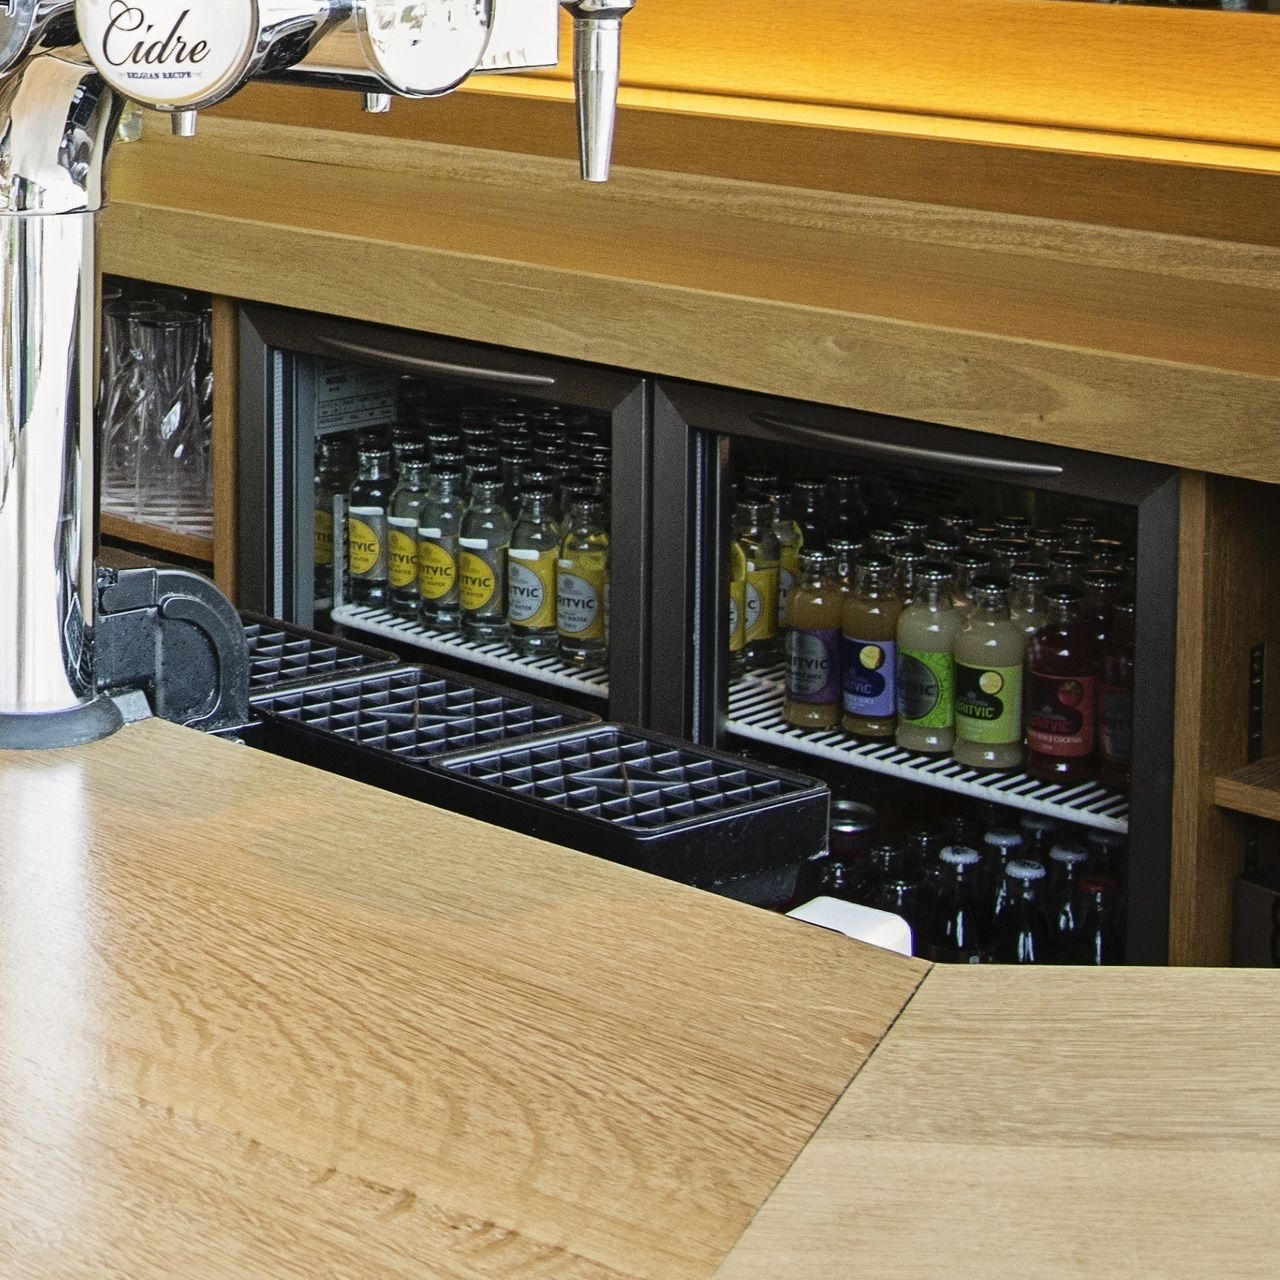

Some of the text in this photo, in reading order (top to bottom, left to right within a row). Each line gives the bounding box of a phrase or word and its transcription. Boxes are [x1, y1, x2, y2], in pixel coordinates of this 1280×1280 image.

[102, 0, 211, 66] Cidre
[127, 71, 192, 80] BELGIAN RECIPE
